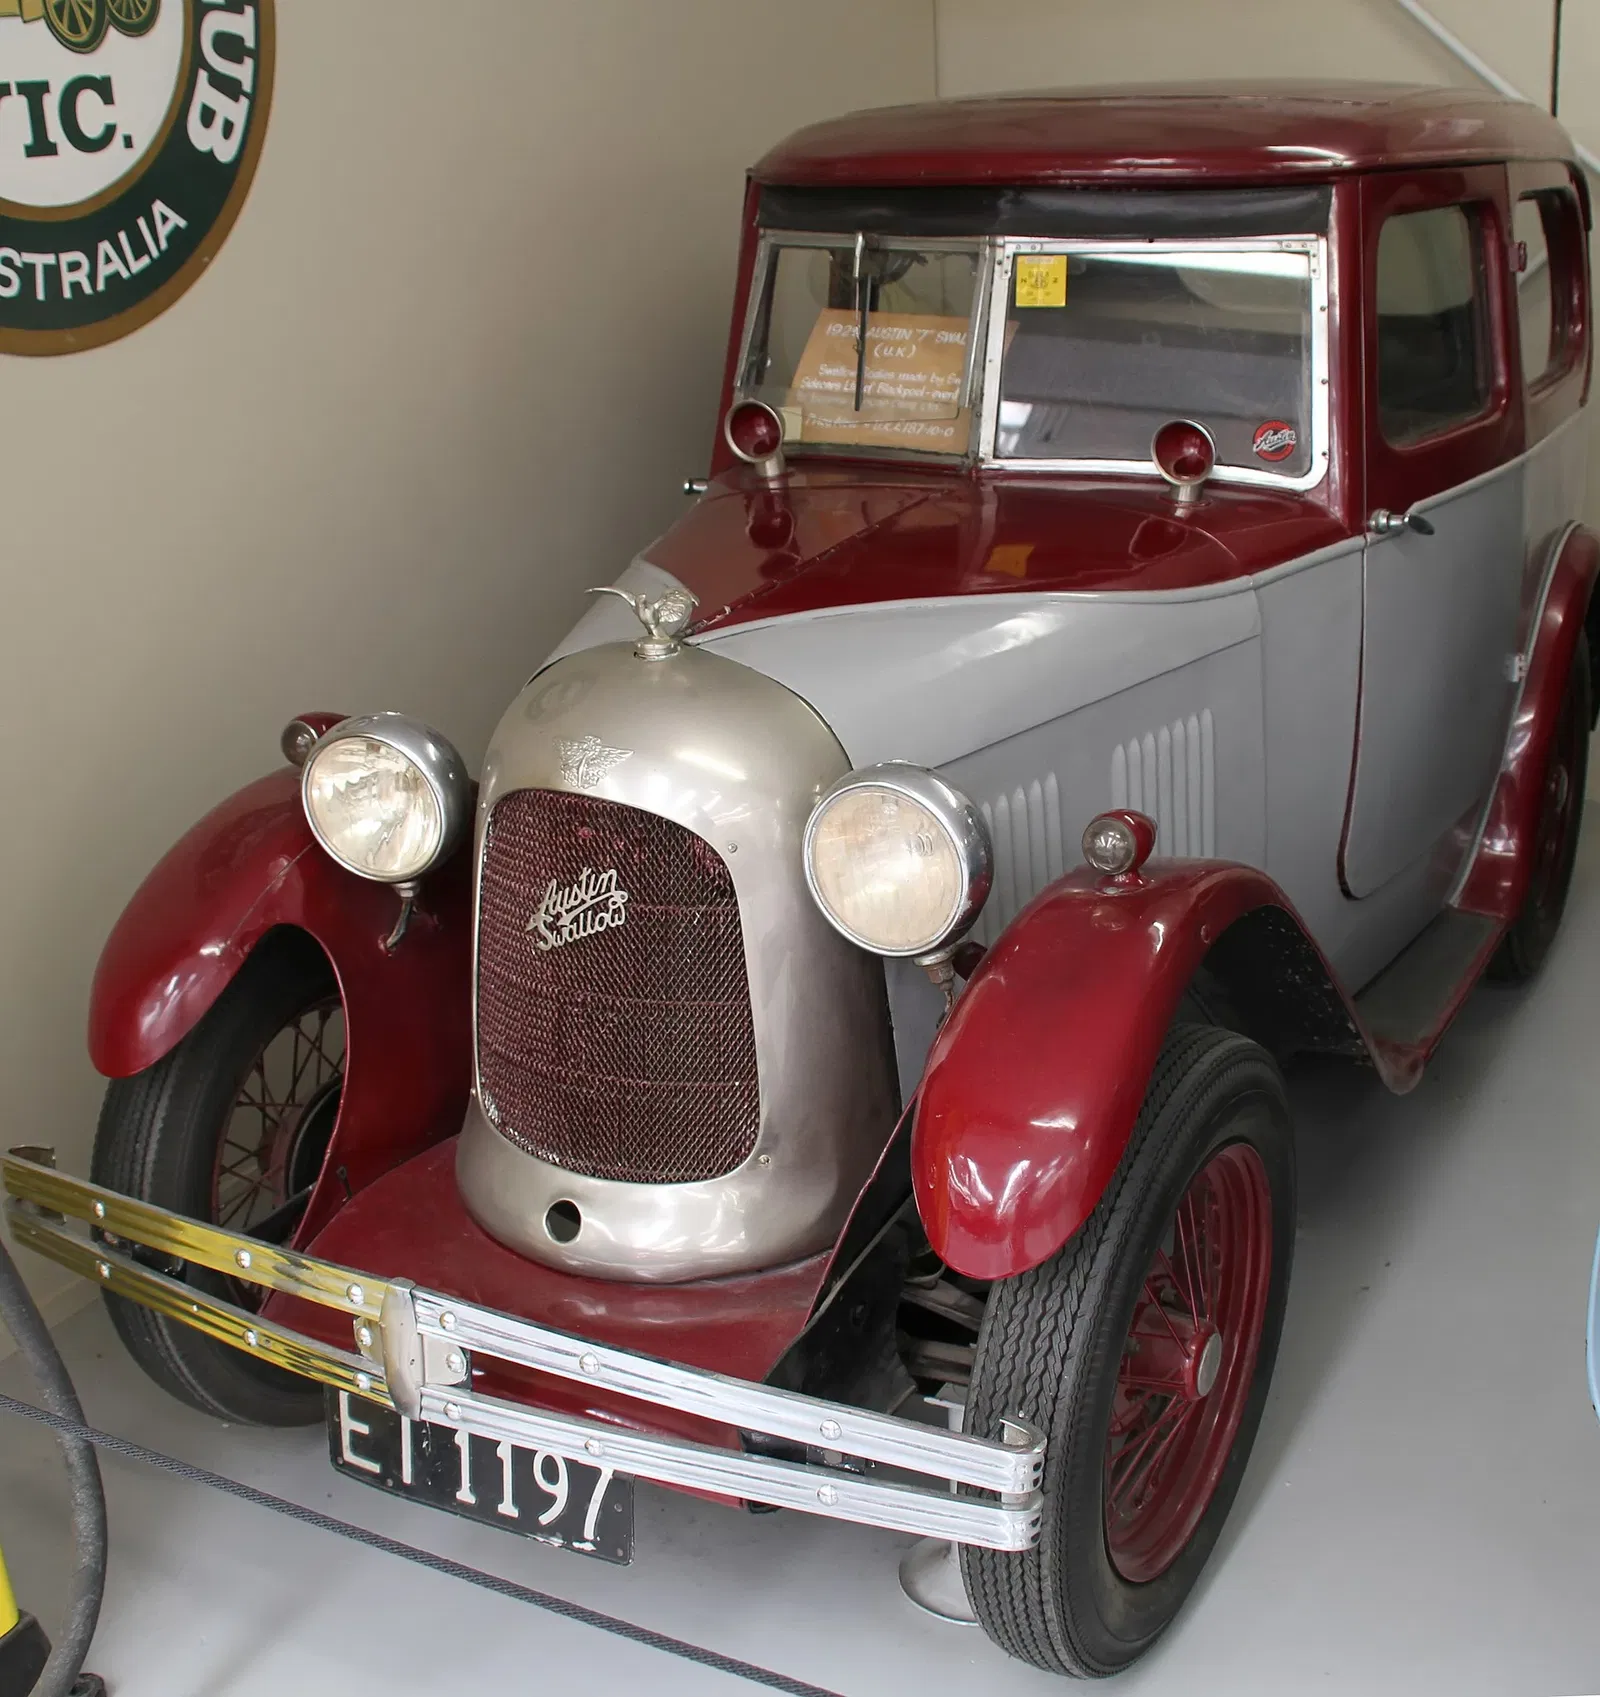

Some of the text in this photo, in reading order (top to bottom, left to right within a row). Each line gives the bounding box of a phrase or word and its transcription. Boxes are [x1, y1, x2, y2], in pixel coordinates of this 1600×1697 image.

[187, 0, 256, 164] UB
[0, 75, 134, 158] IC.
[865, 326, 912, 341] AUSTIN
[525, 866, 620, 932] Austin
[536, 891, 628, 951] Swallow
